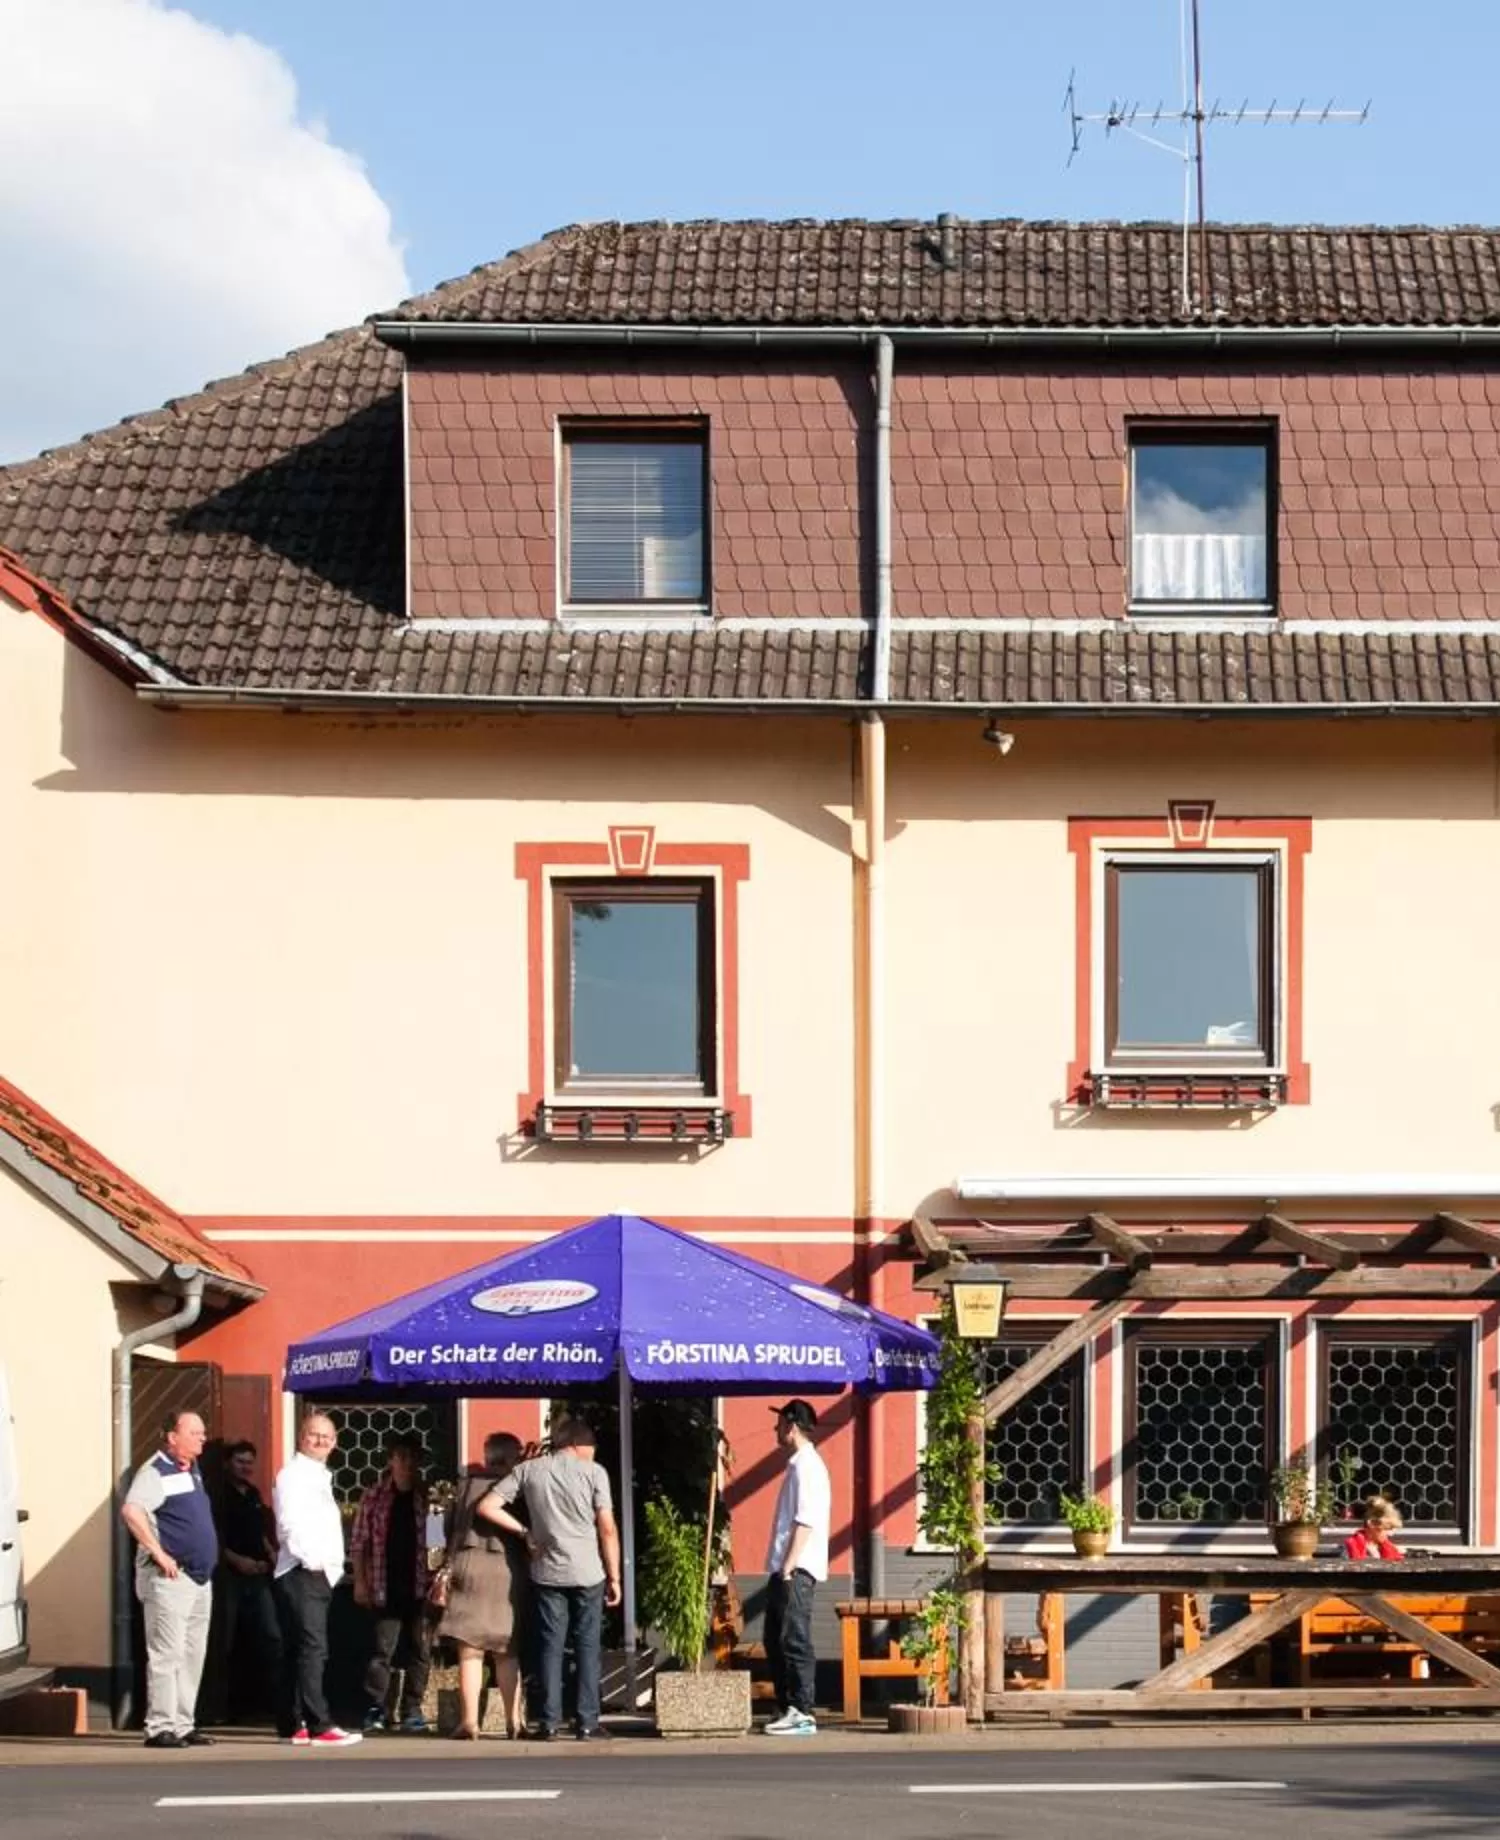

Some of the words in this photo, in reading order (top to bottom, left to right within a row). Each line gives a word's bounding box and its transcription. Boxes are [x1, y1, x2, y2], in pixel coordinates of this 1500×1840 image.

[389, 1346, 426, 1365] Der
[431, 1343, 497, 1364] Schatz
[503, 1341, 537, 1362] der
[543, 1342, 604, 1363] Rhön.
[647, 1339, 750, 1365] FÖRSTINA
[754, 1343, 845, 1366] SPRUDEL
